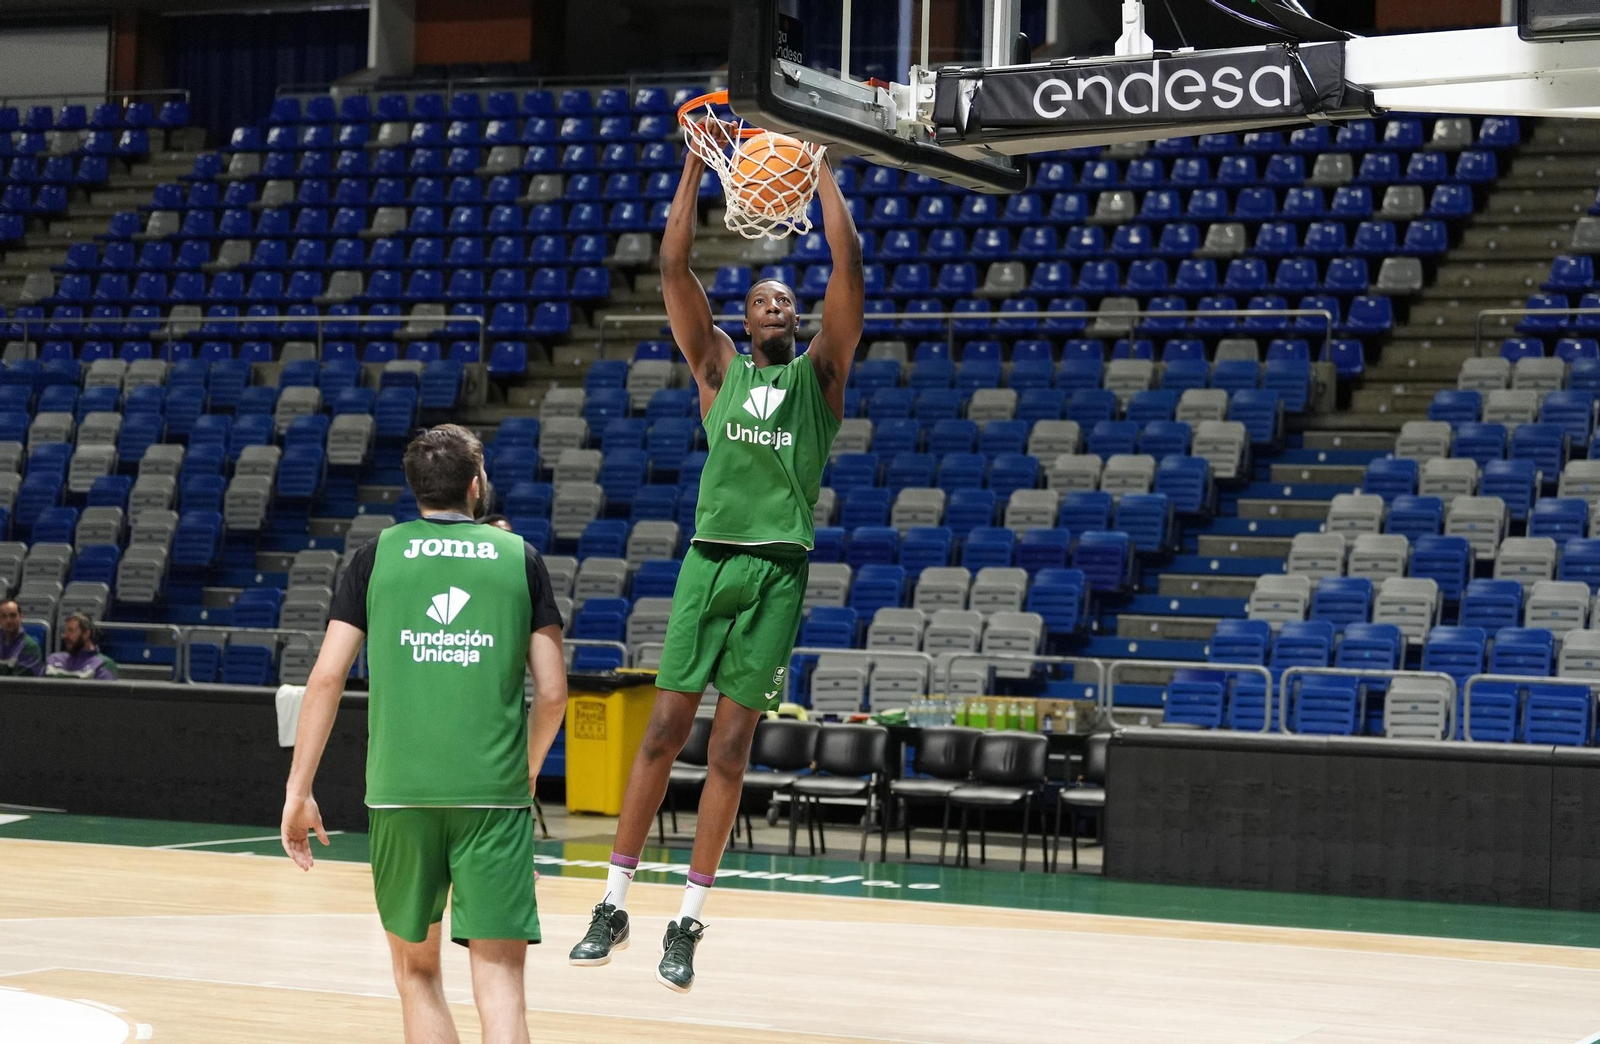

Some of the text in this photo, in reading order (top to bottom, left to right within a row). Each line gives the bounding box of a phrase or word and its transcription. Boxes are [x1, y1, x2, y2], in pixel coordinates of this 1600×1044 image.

[1033, 60, 1291, 119] endesa
[726, 422, 793, 451] Unicaja
[403, 538, 499, 560] Joma
[400, 629, 494, 648] Fundación
[412, 645, 480, 667] Unicaja
